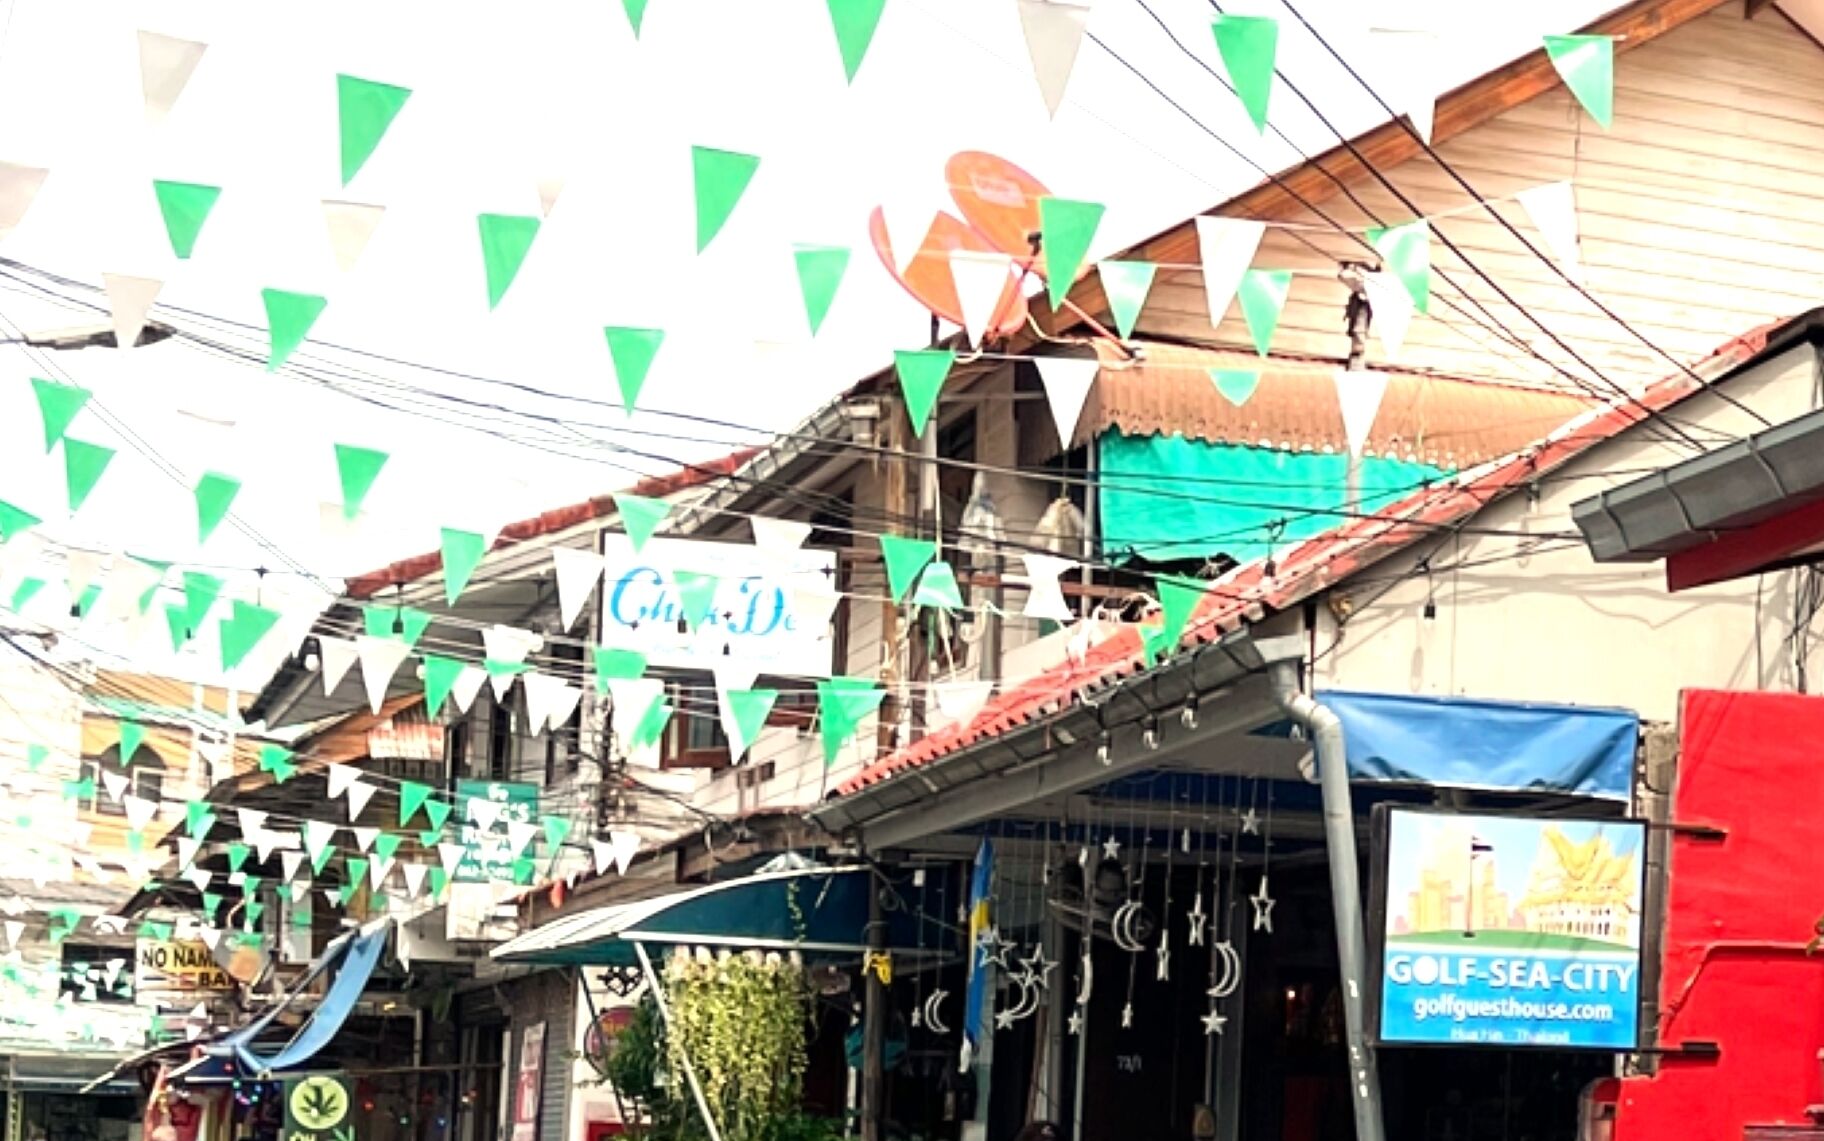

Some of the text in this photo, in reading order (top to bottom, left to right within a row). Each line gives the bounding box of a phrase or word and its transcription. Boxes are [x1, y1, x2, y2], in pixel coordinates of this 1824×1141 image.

[142, 948, 218, 967] NO NAM
[1386, 954, 1635, 993] GOLF-SEA-CITY
[1413, 994, 1613, 1022] golfguesthouse.com
